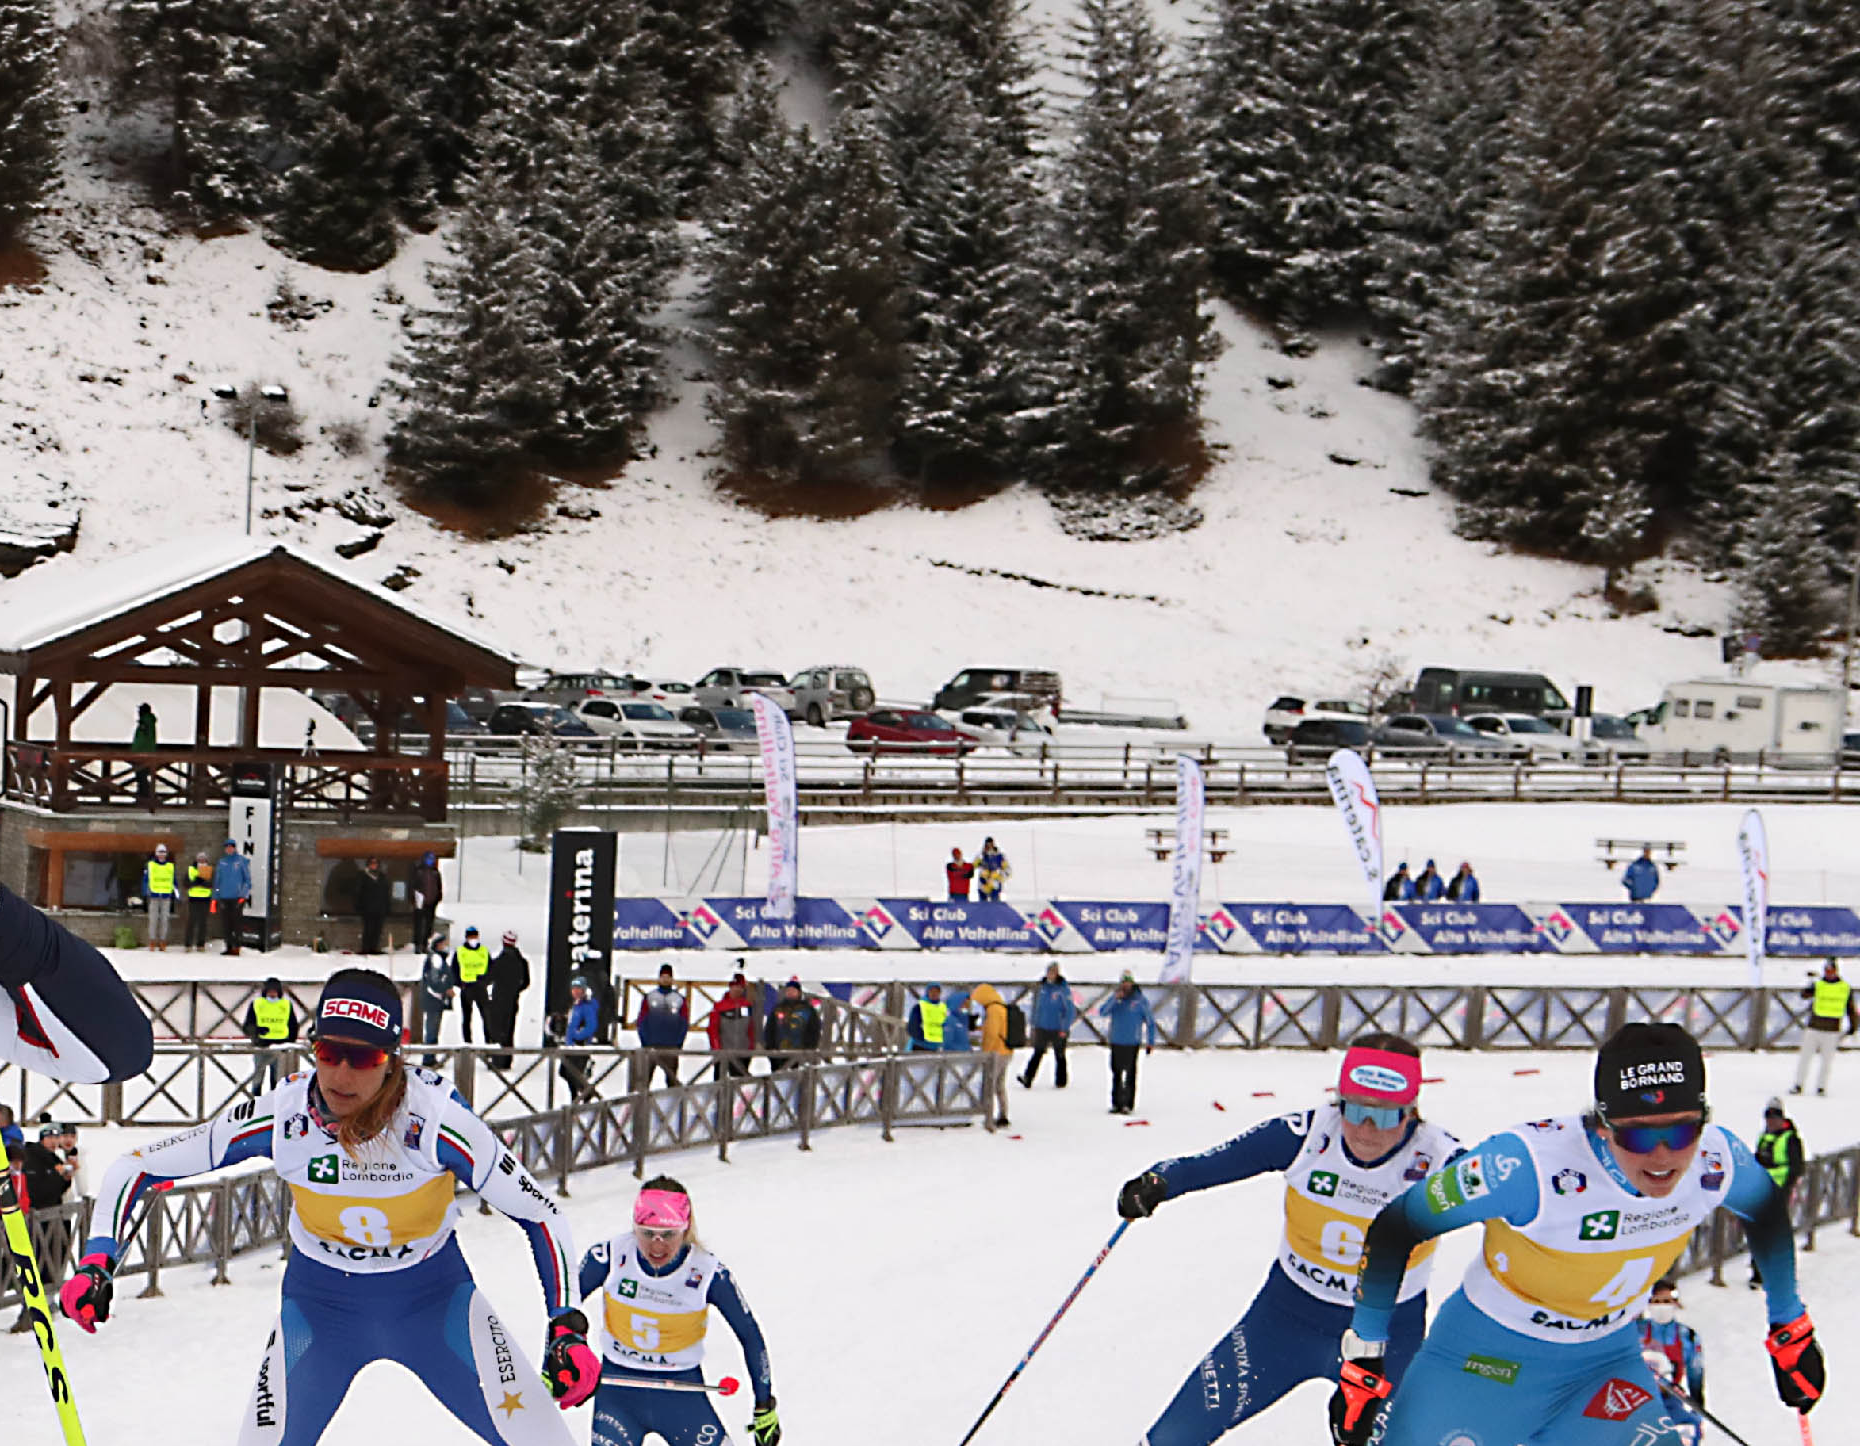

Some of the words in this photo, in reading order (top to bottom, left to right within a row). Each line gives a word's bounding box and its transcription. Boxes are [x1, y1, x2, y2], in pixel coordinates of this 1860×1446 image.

[735, 905, 756, 920] Sci
[909, 907, 929, 922] Sci
[932, 908, 967, 922] Club
[1080, 908, 1101, 923] Sci
[1105, 908, 1139, 923] Club
[1251, 911, 1273, 925] Sci
[1275, 911, 1308, 926] Club
[1421, 911, 1442, 925] Sci
[1444, 911, 1478, 926] Club
[1612, 911, 1645, 925] Club
[749, 924, 781, 940] Alta
[786, 924, 857, 941] Valtellina
[923, 926, 956, 941] Alta
[958, 927, 1030, 942] Valtellina
[1094, 927, 1127, 942] Alta
[1265, 930, 1298, 944] Alta
[1433, 930, 1464, 944] Alta
[324, 1000, 388, 1028] SCAME
[1620, 1065, 1636, 1080] LE
[1637, 1060, 1684, 1077] GRAND
[1620, 1072, 1685, 1091] BORNAND
[148, 1124, 207, 1153] ESERCITO
[342, 1171, 414, 1183] Lombardia
[1624, 1205, 1679, 1223] Regione
[339, 1205, 392, 1247] 8
[1321, 1220, 1365, 1265] 6
[1588, 1255, 1656, 1309] 4
[13, 1253, 70, 1406] RCS
[629, 1312, 660, 1351] 5
[486, 1314, 517, 1385] ESERCITO
